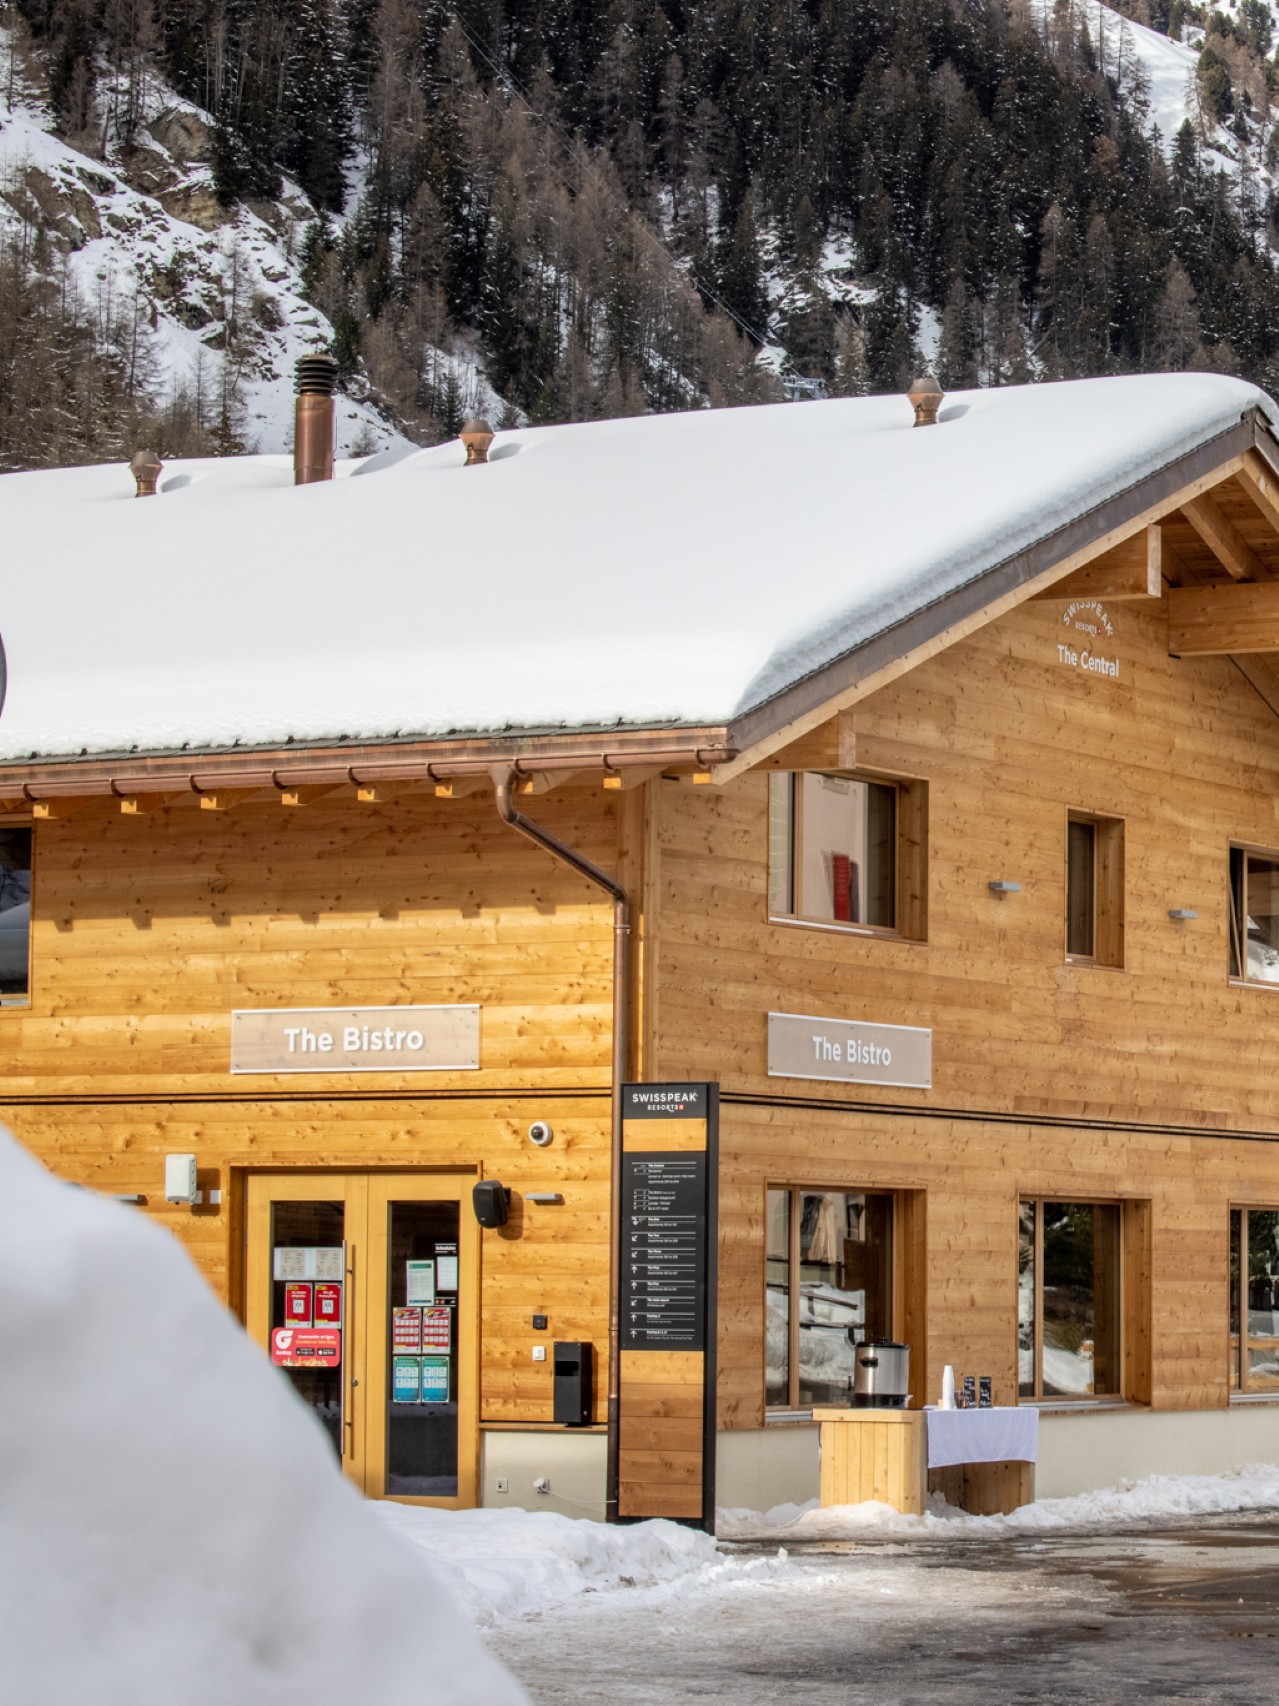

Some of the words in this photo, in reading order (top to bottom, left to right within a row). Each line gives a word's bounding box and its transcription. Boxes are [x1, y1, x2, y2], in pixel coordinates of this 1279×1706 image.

[1058, 645, 1078, 666] The
[1080, 652, 1119, 677] Central
[283, 1026, 334, 1052] The
[343, 1025, 425, 1052] Bistro
[812, 1035, 842, 1062] The
[847, 1039, 891, 1066] Bistro
[632, 1091, 698, 1103] SWISSPEAK
